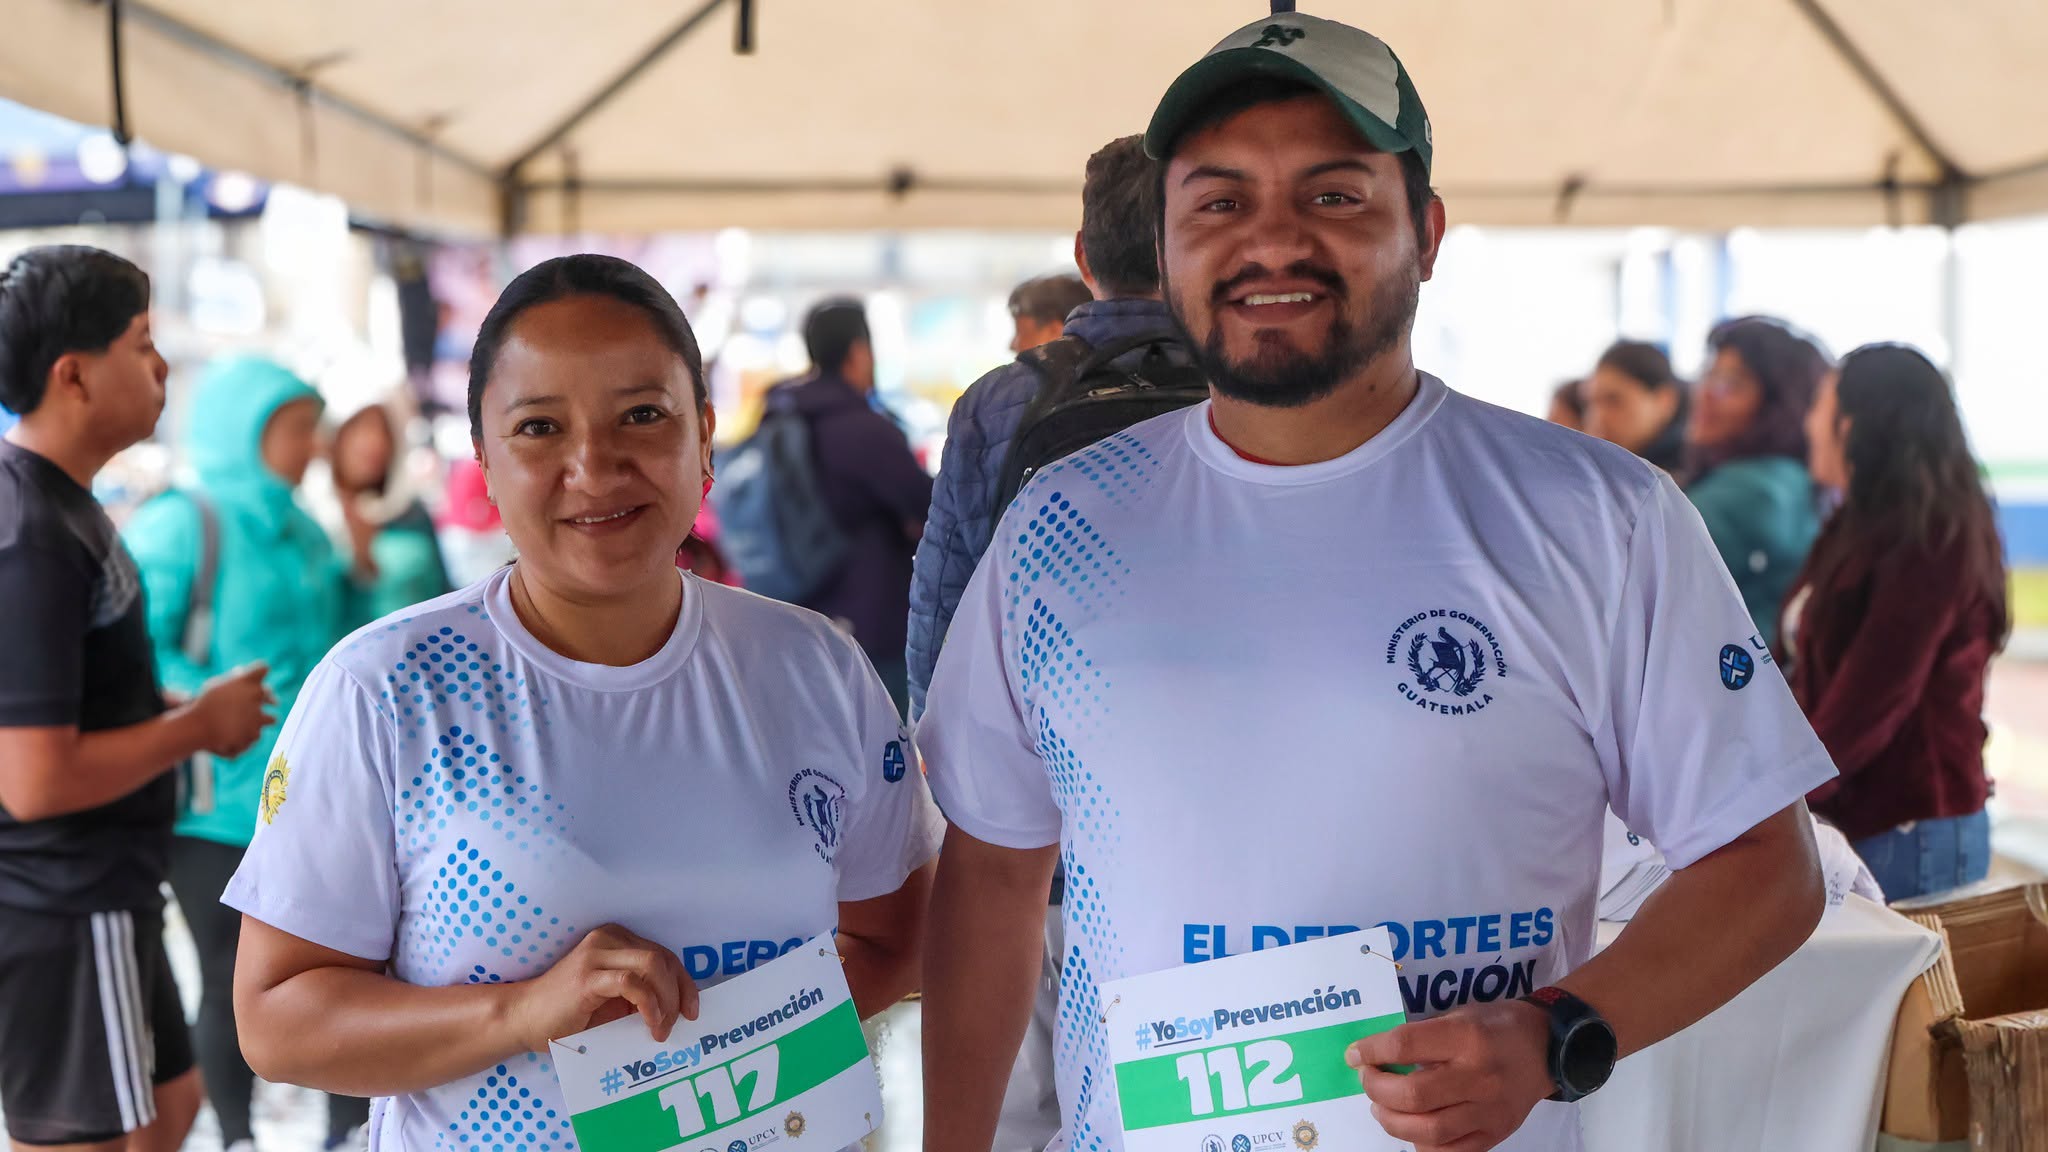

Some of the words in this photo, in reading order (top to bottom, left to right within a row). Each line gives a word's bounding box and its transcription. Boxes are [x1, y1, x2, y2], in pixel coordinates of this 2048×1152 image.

[1386, 612, 1427, 664] MINISTERIO
[1430, 609, 1446, 618] DE
[1449, 610, 1507, 678] GOBERNACIÓN
[1397, 682, 1494, 716] GUATEMALA
[788, 773, 805, 827] MINISTERIO
[801, 768, 812, 777] DE
[1184, 923, 1235, 963] EL
[1252, 914, 1500, 960] DORTE
[1511, 907, 1554, 948] ES
[1398, 955, 1537, 1014] NCIÓN
[600, 987, 824, 1096] #YoSoyPrevención
[1135, 985, 1362, 1051] #YoSoyPrevención
[658, 1043, 780, 1138] 117
[1175, 1039, 1304, 1116] 112
[748, 1126, 777, 1145] UPCV
[1252, 1131, 1284, 1145] UPCV
